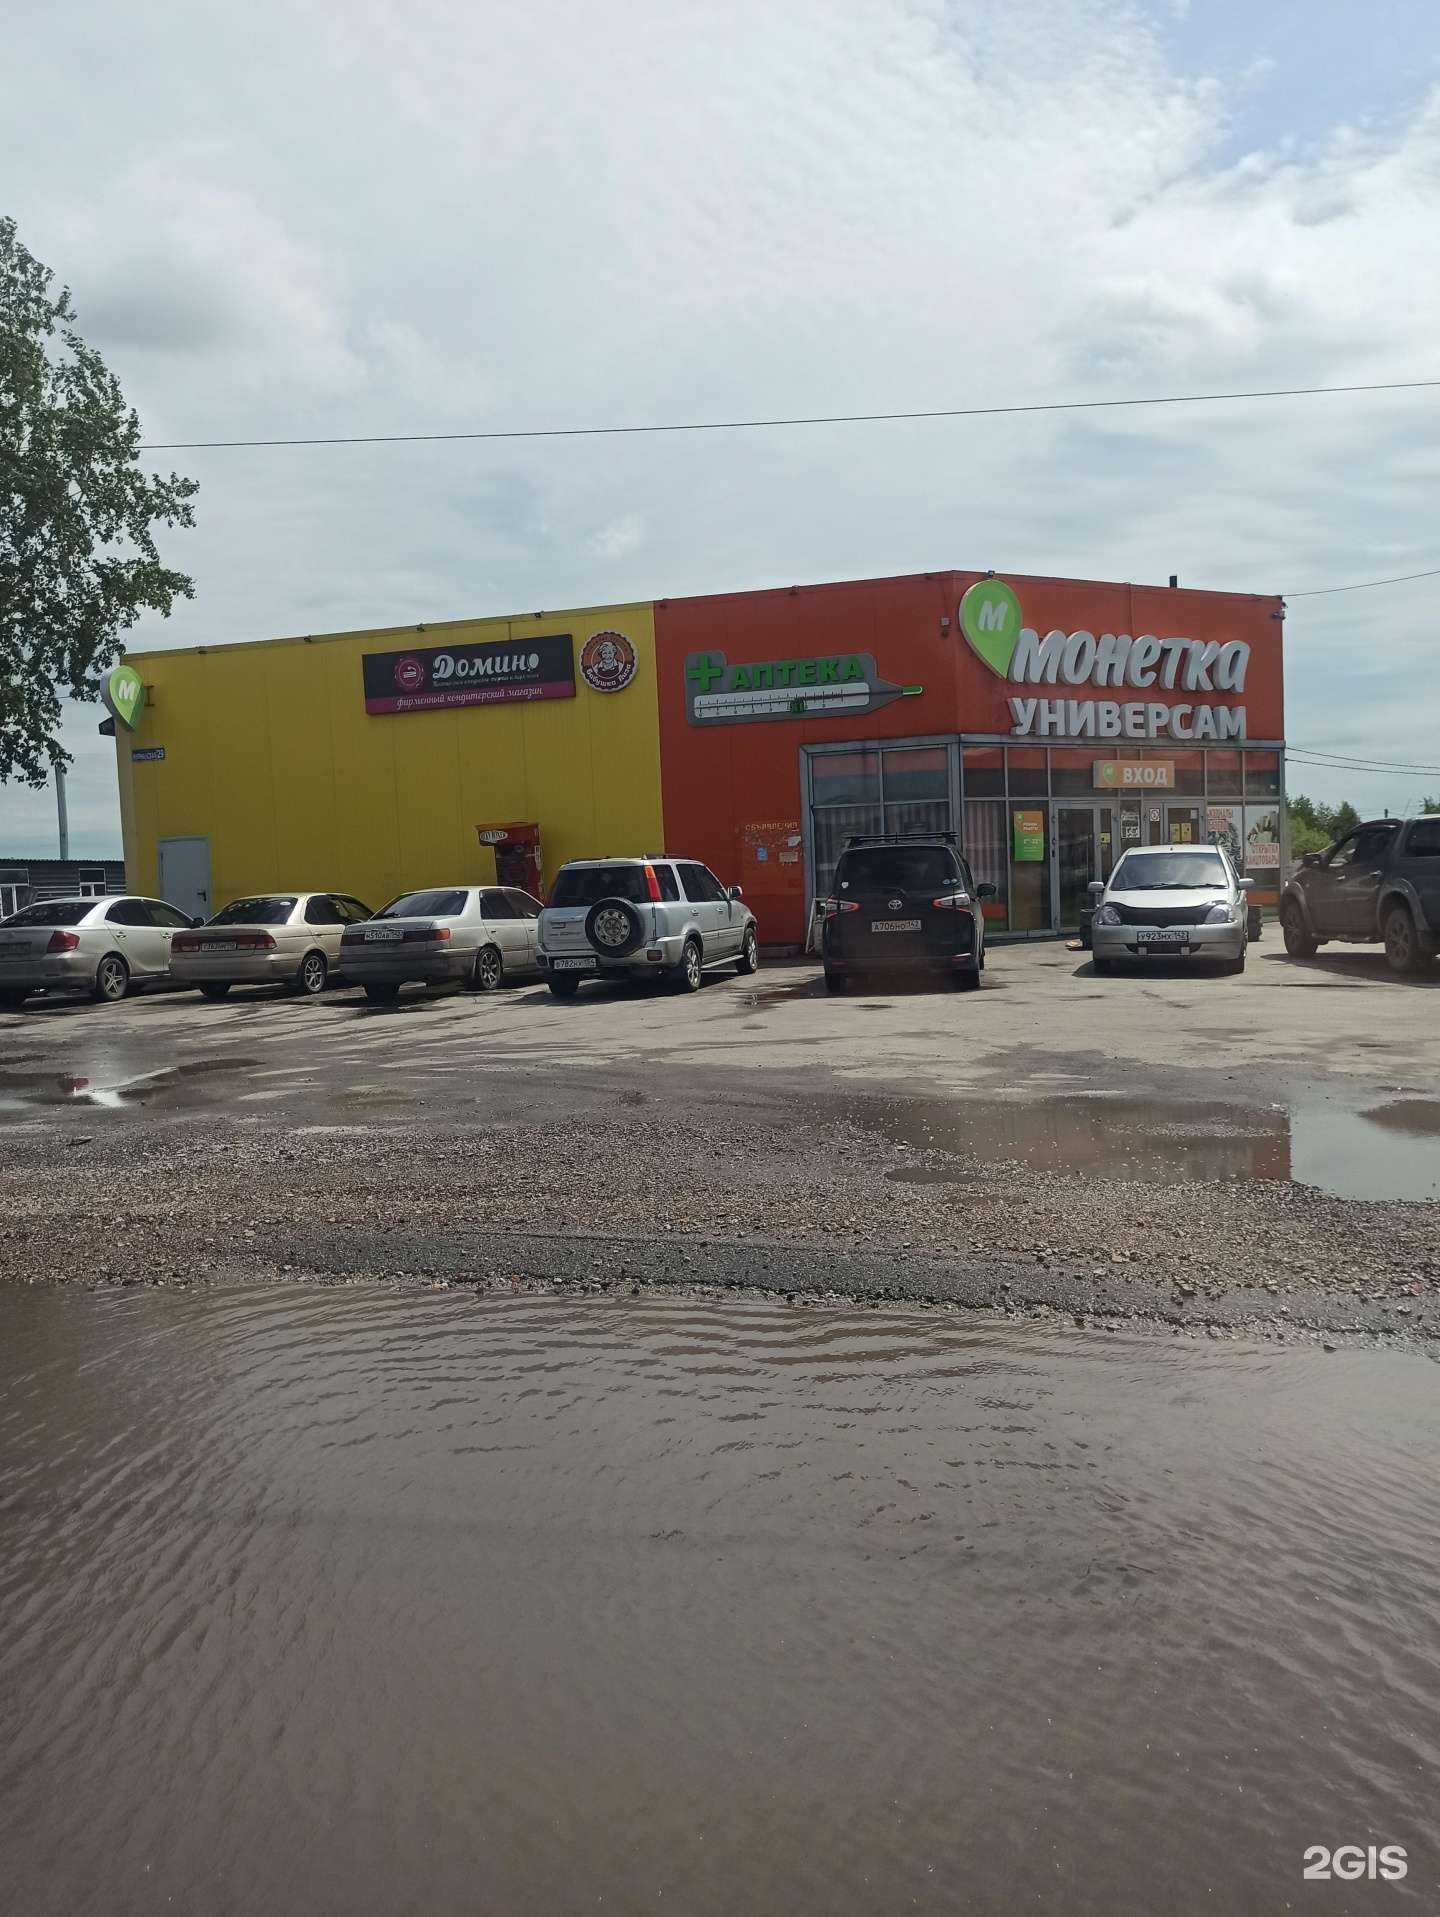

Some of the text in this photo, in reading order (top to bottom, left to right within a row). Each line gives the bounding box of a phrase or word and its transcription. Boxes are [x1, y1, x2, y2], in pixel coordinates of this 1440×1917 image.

[432, 653, 540, 679] Домино
[733, 655, 867, 691] АПТЕКА
[1010, 698, 1247, 740] УНИВЕРСАМ
[1122, 767, 1168, 786] ВХОД
